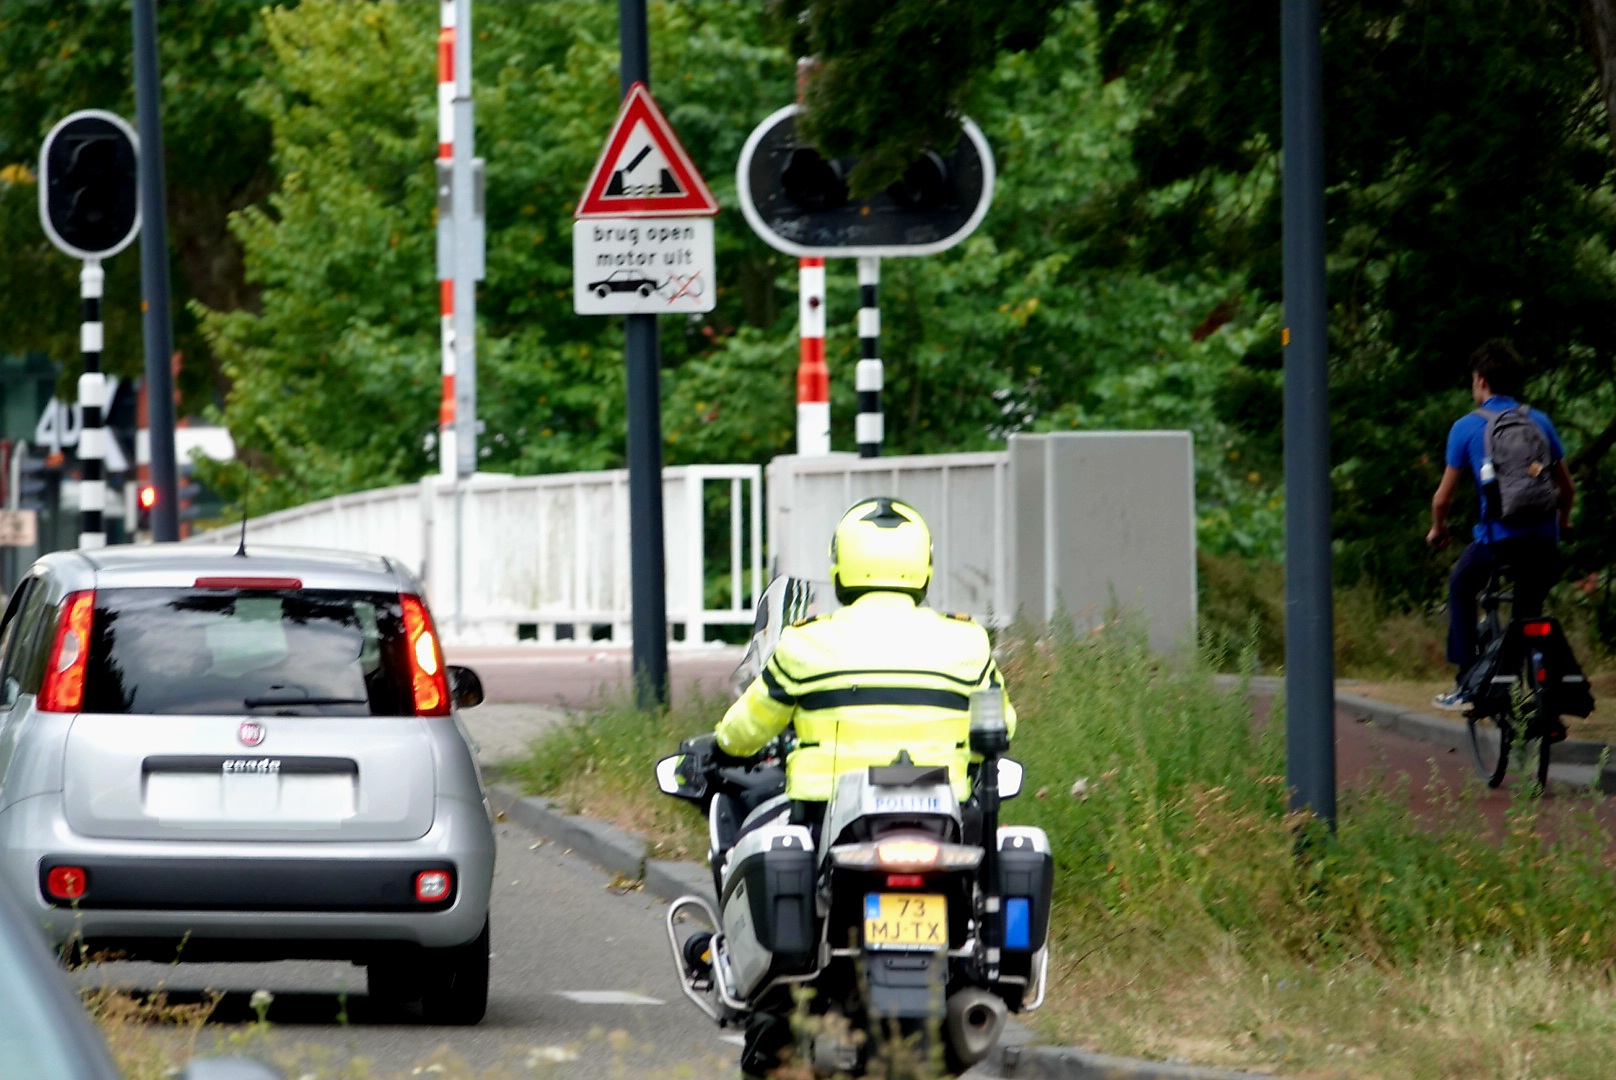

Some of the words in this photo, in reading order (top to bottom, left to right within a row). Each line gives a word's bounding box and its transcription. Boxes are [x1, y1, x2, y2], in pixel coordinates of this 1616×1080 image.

[594, 225, 640, 245] brug
[646, 226, 694, 244] open
[597, 250, 656, 266] motor
[664, 247, 693, 265] uit
[898, 899, 926, 918] 73
